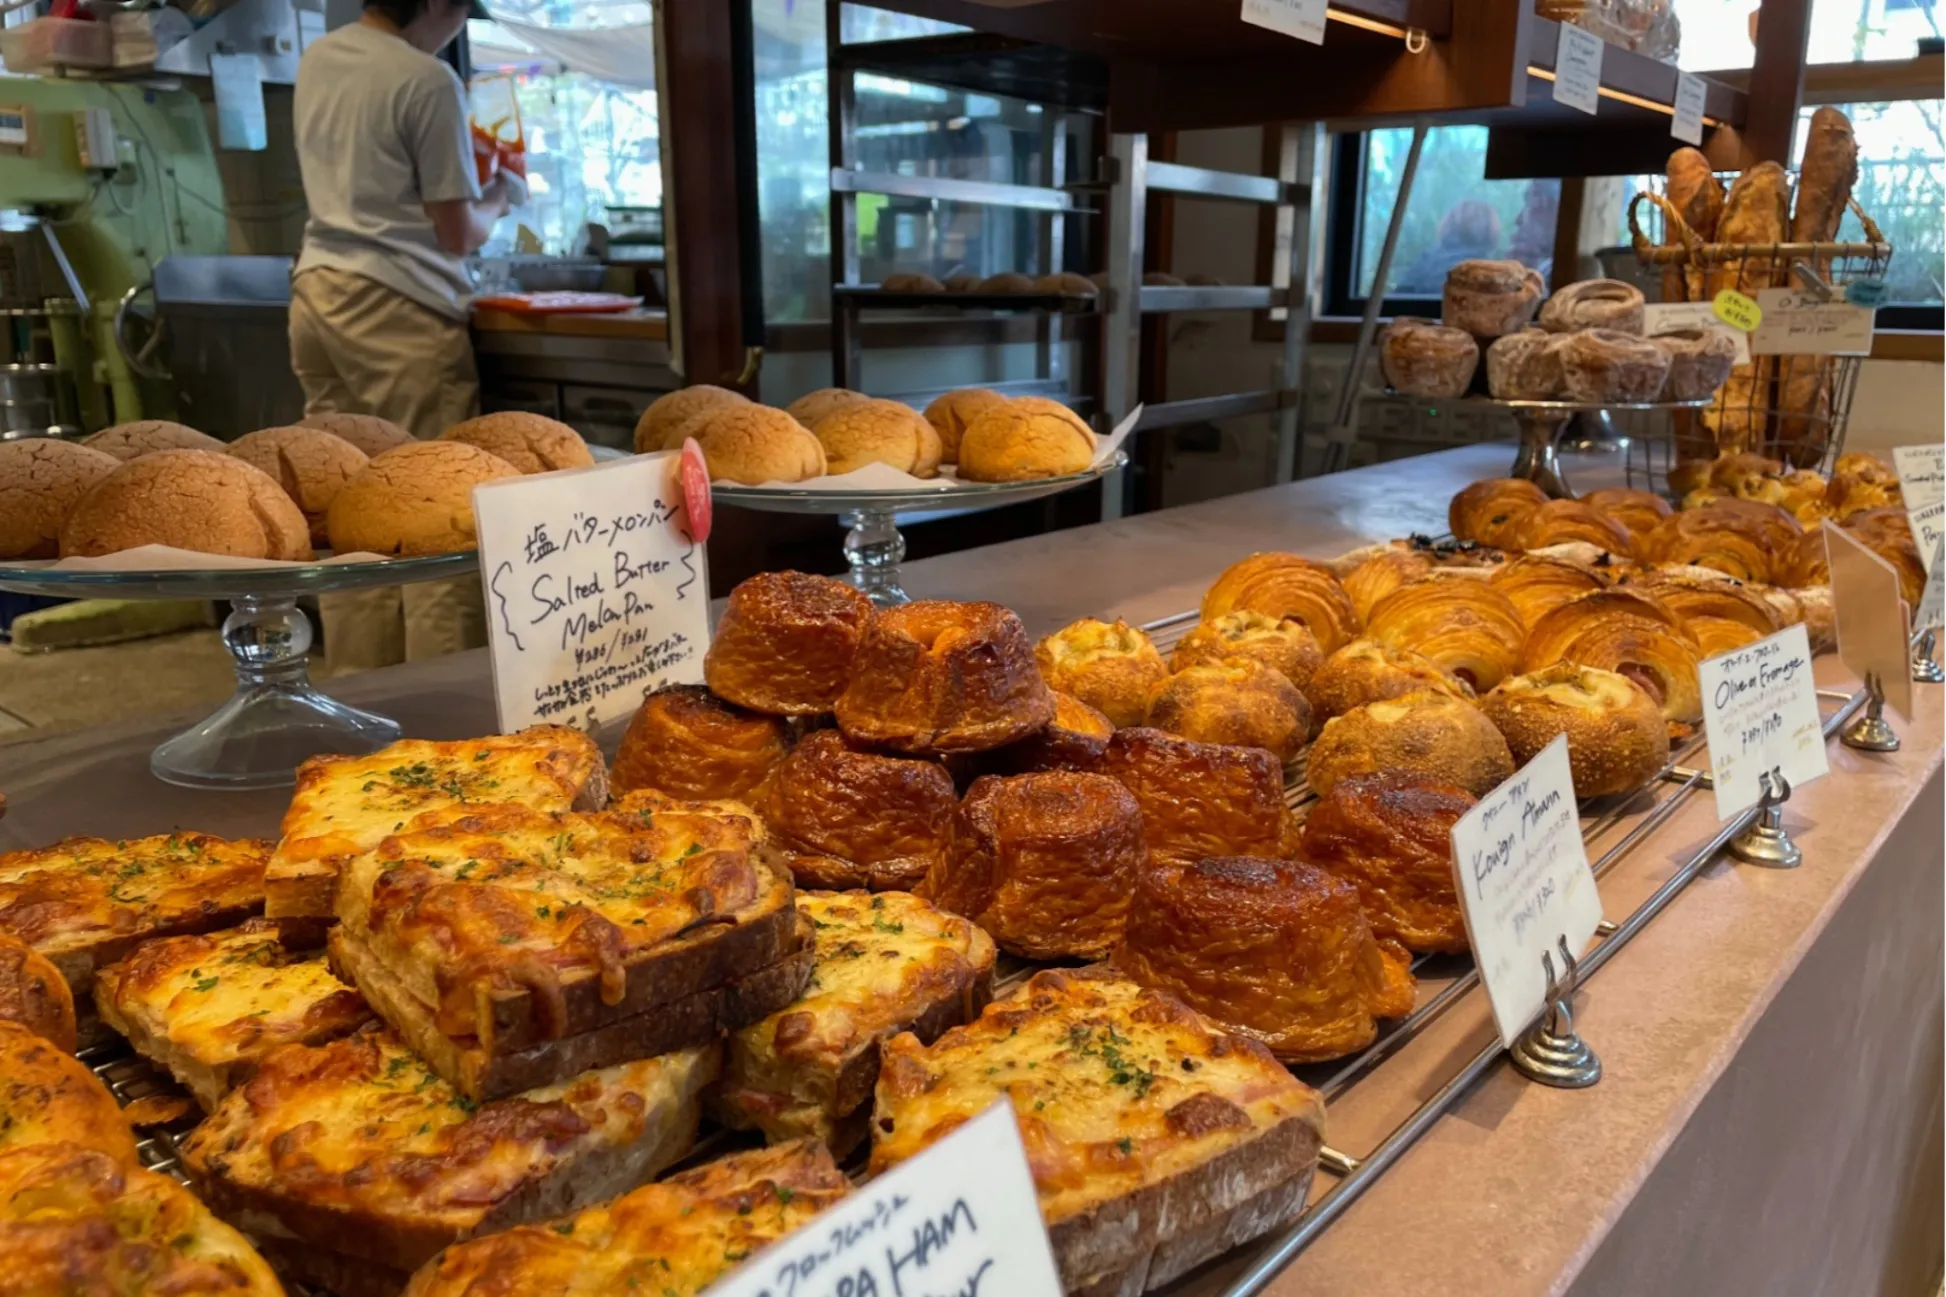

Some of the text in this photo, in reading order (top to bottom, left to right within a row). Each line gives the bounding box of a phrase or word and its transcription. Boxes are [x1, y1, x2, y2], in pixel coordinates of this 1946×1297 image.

[530, 551, 670, 625] Salted Butter
[624, 591, 654, 625] Pan
[1472, 832, 1516, 901] Kouign
[885, 1197, 978, 1297] HAM
